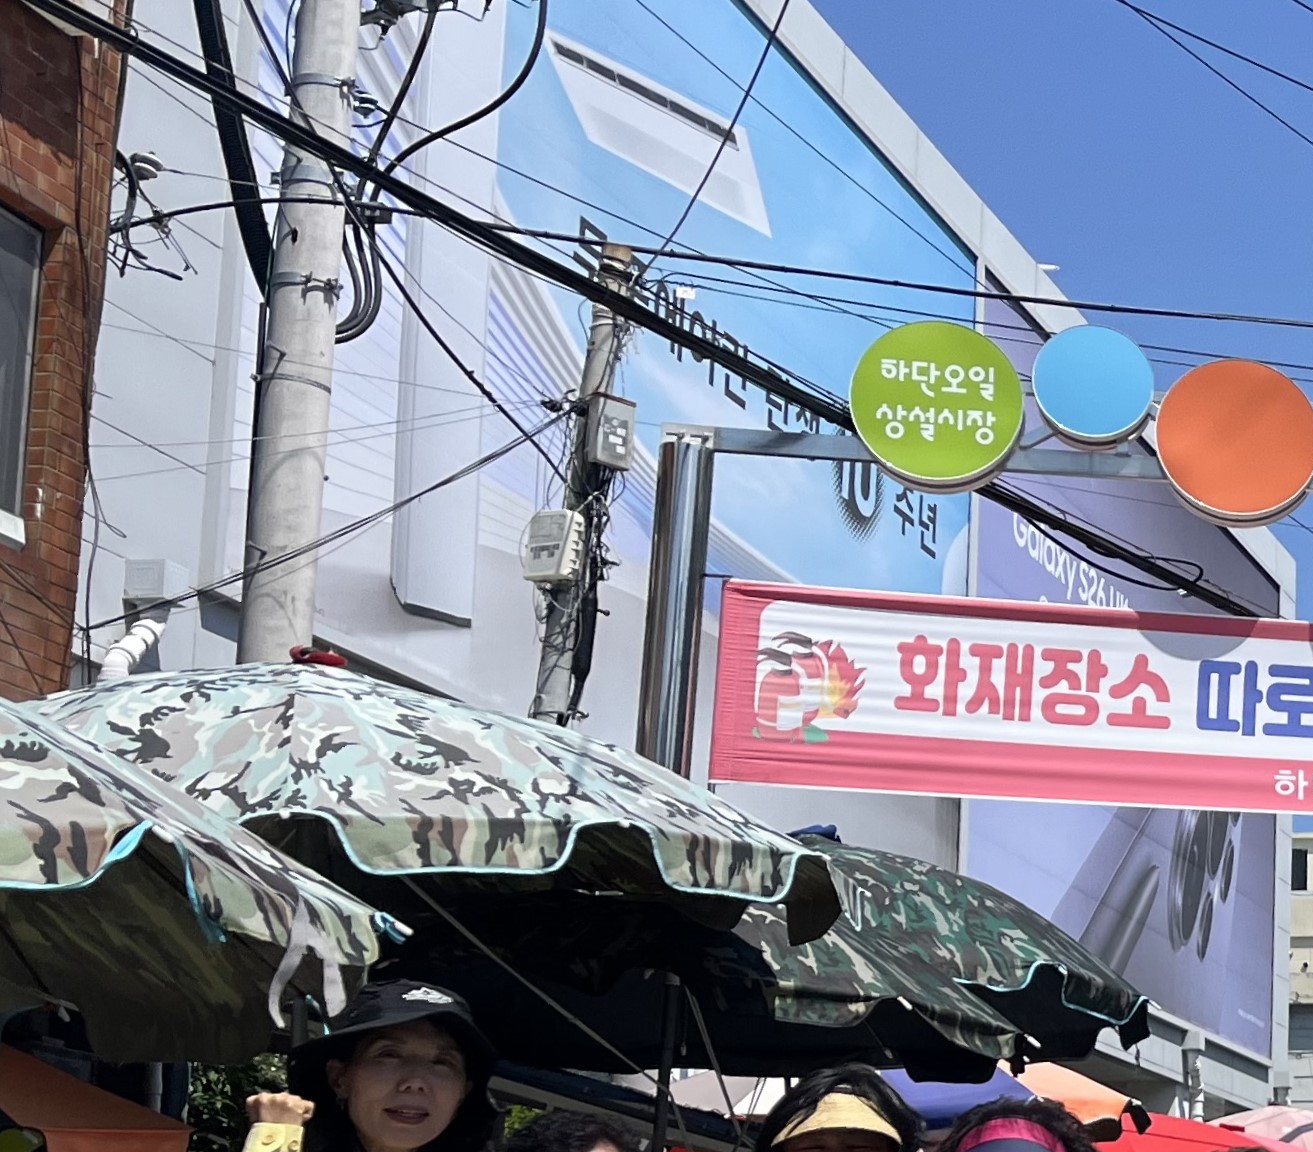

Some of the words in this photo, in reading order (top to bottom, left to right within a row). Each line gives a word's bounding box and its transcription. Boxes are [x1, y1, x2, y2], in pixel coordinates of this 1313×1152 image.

[881, 358, 995, 402] 하단오일
[876, 403, 997, 445] 상설시장
[1013, 510, 1077, 600] Galaxy
[894, 633, 1172, 731] 화재장소
